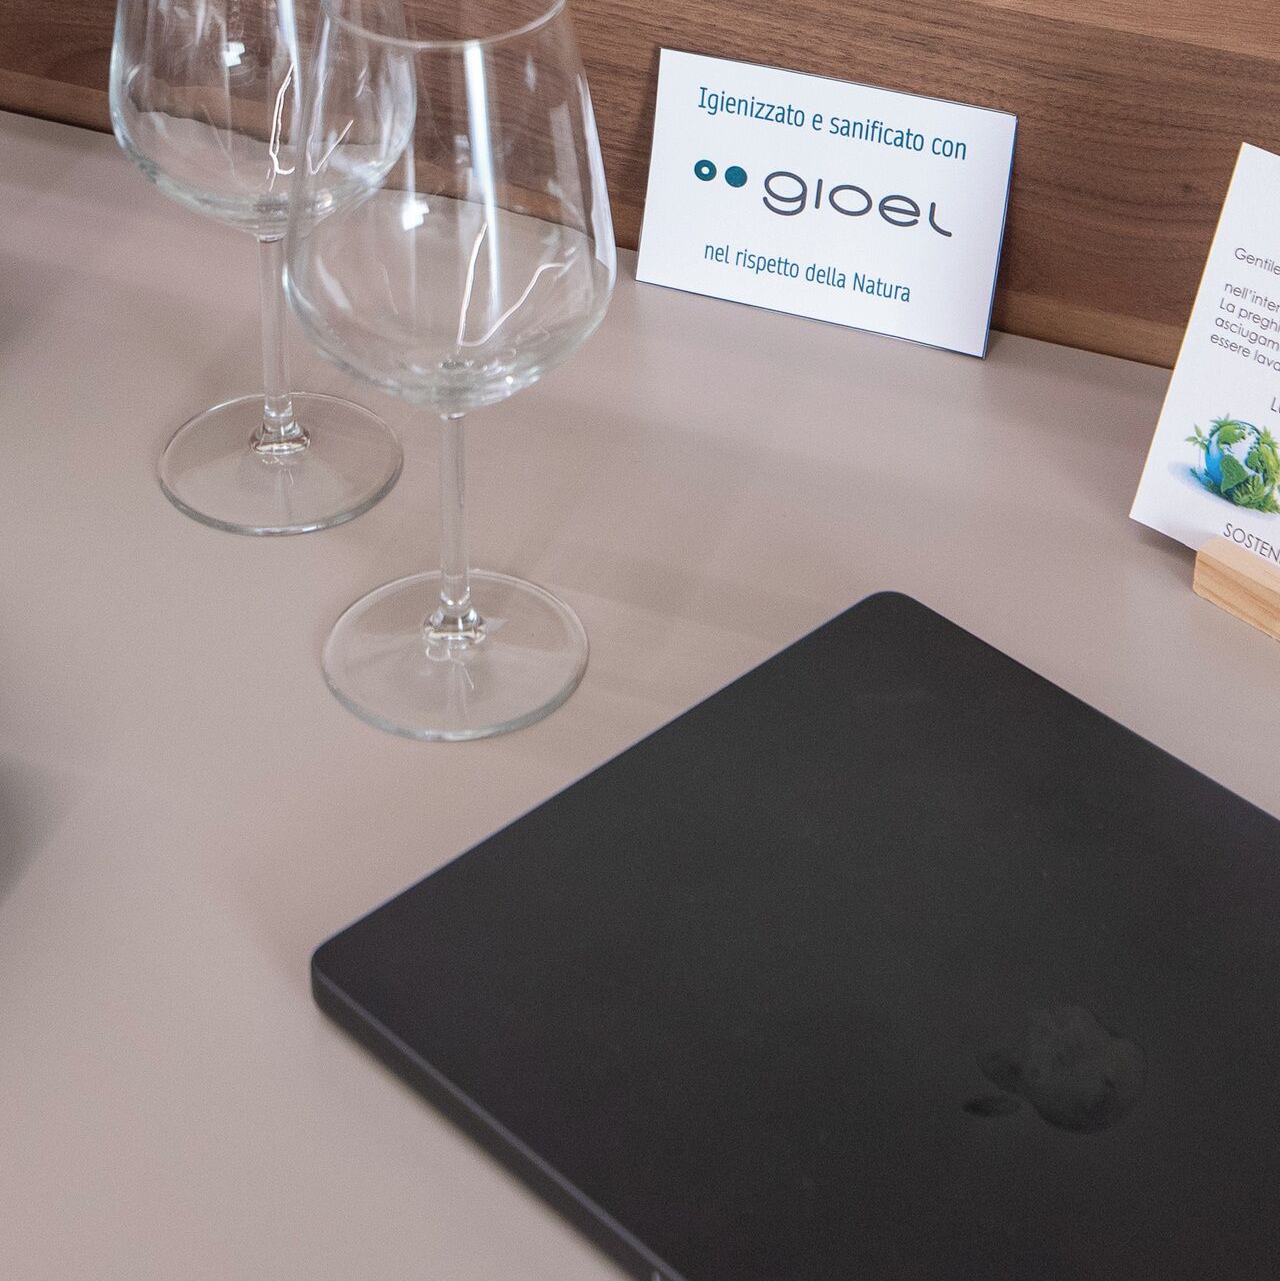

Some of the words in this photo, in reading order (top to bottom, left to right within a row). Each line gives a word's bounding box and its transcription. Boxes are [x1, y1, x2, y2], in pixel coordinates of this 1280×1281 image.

[698, 86, 805, 128] Igienizzato
[812, 113, 823, 131] e
[829, 116, 924, 152] sanificato
[931, 136, 967, 160] con
[704, 242, 730, 265] nel
[735, 248, 800, 280] rispetto
[805, 261, 846, 290] della
[852, 272, 911, 303] Natura
[1219, 298, 1235, 313] La
[1210, 333, 1251, 358] essere
